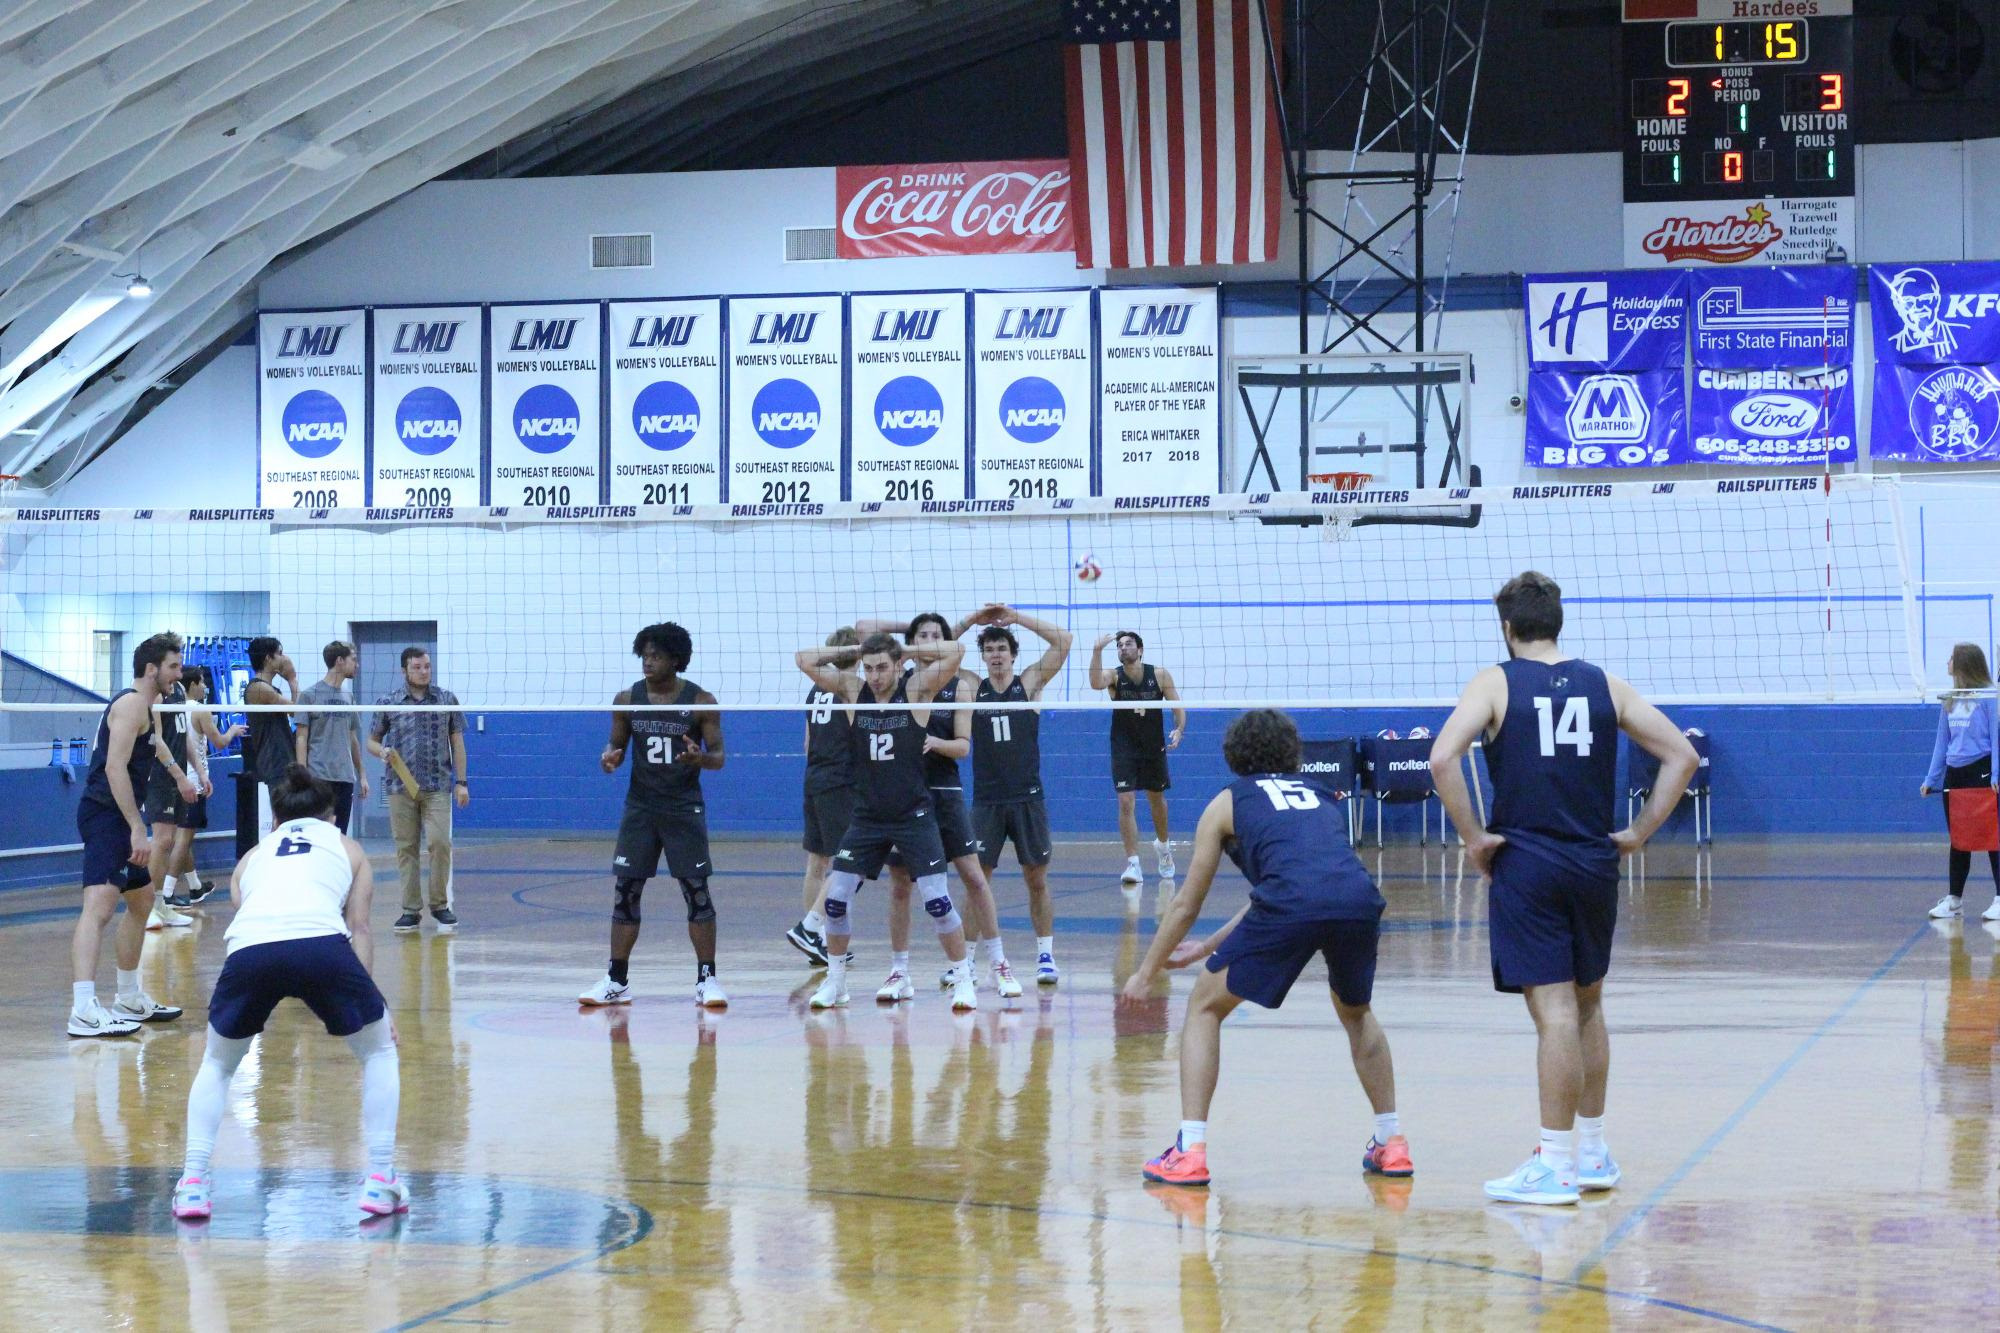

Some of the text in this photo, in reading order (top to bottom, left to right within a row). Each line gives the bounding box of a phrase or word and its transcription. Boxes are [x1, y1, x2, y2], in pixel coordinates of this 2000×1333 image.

[1721, 67, 1753, 78] BONUS
[1725, 78, 1750, 89] POSS
[1820, 74, 1841, 110] 3
[1668, 79, 1689, 115] 2
[1714, 89, 1760, 102] PERIOD
[1637, 118, 1687, 136] HOME
[1740, 104, 1746, 132] 1
[1780, 114, 1848, 132] VISITOR
[1641, 139, 1680, 152] FOULS
[1714, 137, 1766, 150] NO F
[1796, 134, 1835, 148] FOULS
[1673, 154, 1680, 183] 1
[1724, 152, 1742, 181] 0
[1828, 150, 1834, 178] 1
[900, 173, 967, 188] DRINK
[842, 171, 1071, 240] Coca-Cola
[1781, 200, 1838, 211] Harrogate
[1790, 212, 1837, 222] Tazewell
[1790, 225, 1837, 237] Rutledge
[1782, 238, 1837, 249] Sneedville
[1612, 296, 1683, 311] Holiday Inn
[1706, 300, 1734, 314] FSF
[1945, 293, 2000, 318] KF
[749, 312, 819, 345] LMU
[871, 309, 941, 342] LMU
[994, 306, 1067, 339] LMU
[1120, 303, 1194, 337] LMU
[1613, 313, 1681, 334] Express
[277, 322, 347, 358] LMU
[391, 320, 462, 355] LMU
[508, 318, 580, 352] LMU
[627, 315, 698, 349] LMU
[1700, 329, 1848, 349] First State Financial
[736, 353, 838, 366] WOMEN'S VOLLEYBALL
[858, 350, 961, 363] WOMEN'S VOLLEYBALL
[981, 349, 1086, 361] WOMEN'S VOLLEYBALL
[1107, 345, 1213, 359] WOMEN'S VOLLEYBALL
[266, 365, 362, 379] WOMEN'S VOLLEYBALL
[380, 362, 478, 375] WOMEN'S VOLLEYBALL
[497, 360, 597, 373] WOMEN'S VOLLEYBALL
[616, 356, 717, 370] WOMEN'S VOLLEYBALL
[1105, 381, 1215, 394] ACADEMIC ALL-AMERICAN
[1114, 399, 1205, 411] PLAYER OF THE YEAR
[1741, 400, 1808, 428] Ford
[639, 415, 698, 434] NCAA
[759, 412, 818, 431] NCAA
[881, 410, 941, 429] NCAA
[1006, 408, 1064, 427] NCAA
[1579, 421, 1636, 431] MARATHON
[289, 422, 344, 441] NCAA
[402, 419, 459, 438] NCAA
[520, 418, 577, 437] NCAA
[1121, 429, 1200, 441] ERICA WHITAKER
[1931, 424, 1979, 449] BBQ
[1544, 445, 1606, 464] BIG
[1695, 436, 1851, 454] 606-248-3350
[858, 459, 959, 472] SOUTHEAST REGIONAL
[981, 458, 1084, 470] SOUTHEAST REGIONAL
[1122, 450, 1200, 462] 2017 2018
[267, 469, 360, 483] SOUTHEAST REGIONAL
[379, 467, 475, 480] SOUTHEAST REGIONAL
[497, 466, 595, 479] SOUTHEAST REGIONAL
[616, 463, 715, 476] SOUTHEAST REGIONAL
[735, 461, 835, 474] SOUTHEAST REGIONAL
[405, 487, 451, 508] 2009
[523, 485, 570, 506] 2010
[643, 482, 689, 505] 2011
[762, 481, 811, 503] 2012
[885, 479, 934, 501] 2016
[1008, 478, 1058, 498] 2018
[17, 478, 1817, 520] RAILSPLITTERS LMU RAILSPLITTERS LMU RAILSPLITTERS LMU RAILSPLITTERS LMU RAILSPLITTERS LMU RAILSPLITTERS LMU RAILSPLITTERS LMU RAILSPLITTERS LMU RAILSPLITTERS LMU RAILSPLITTERS
[293, 489, 338, 508] 2008
[811, 691, 834, 724] 13
[991, 715, 1011, 742] 11
[1533, 696, 1593, 756] 14
[647, 736, 672, 764] 21
[870, 733, 895, 760] 12
[1389, 759, 1430, 771] molten
[1255, 778, 1320, 811] 15
